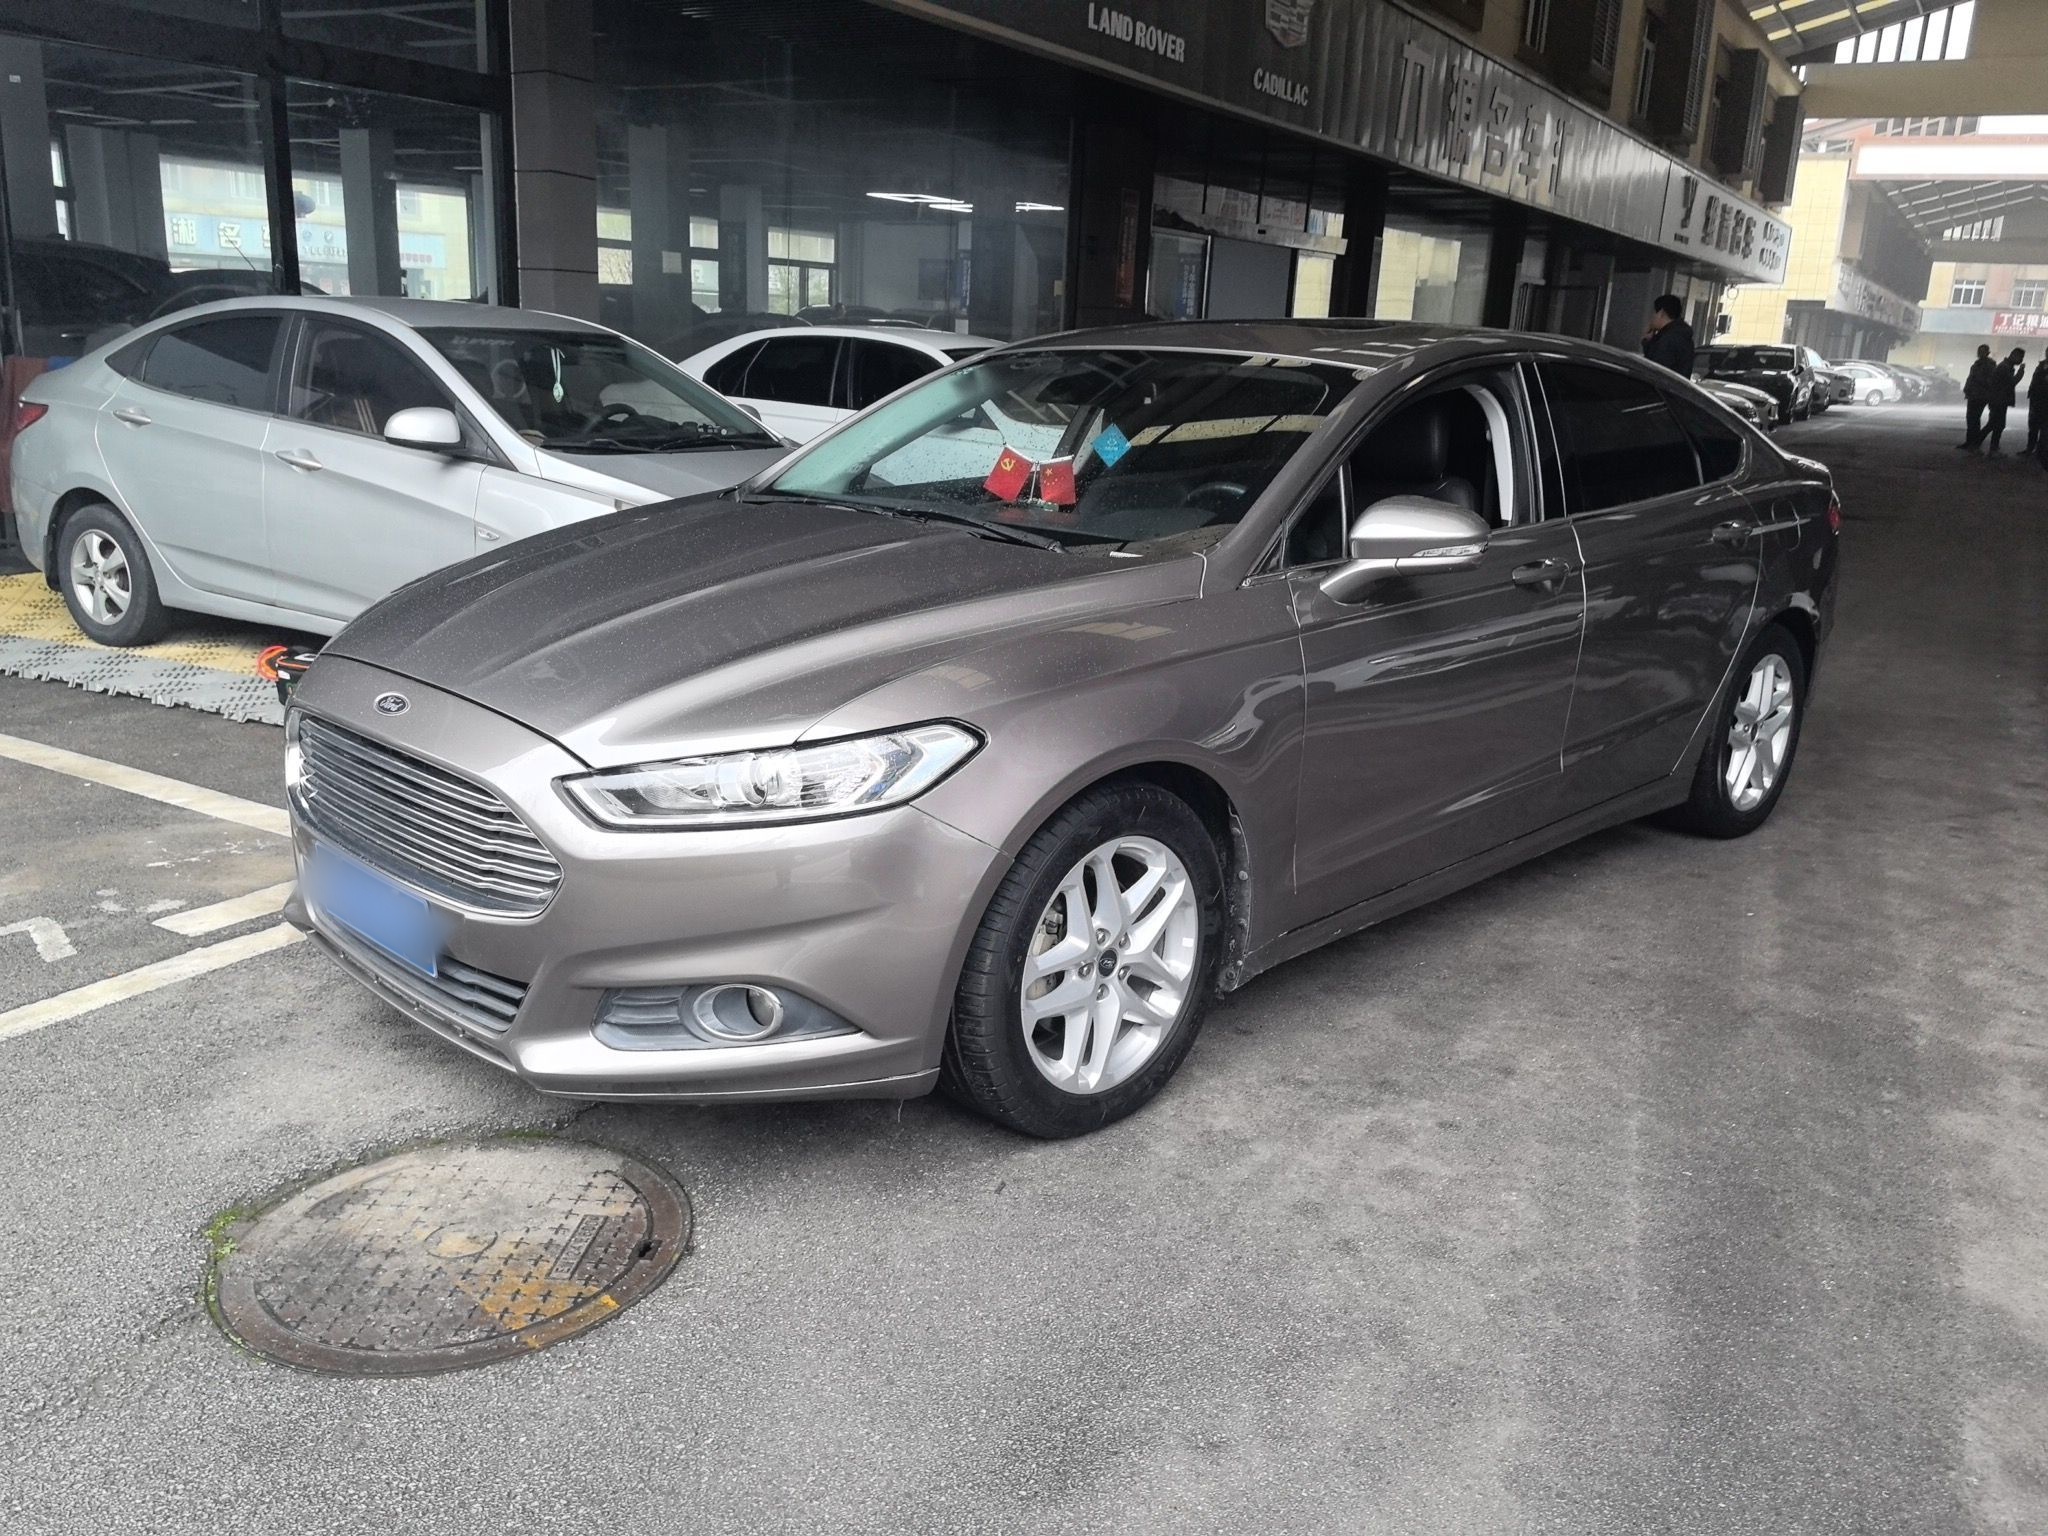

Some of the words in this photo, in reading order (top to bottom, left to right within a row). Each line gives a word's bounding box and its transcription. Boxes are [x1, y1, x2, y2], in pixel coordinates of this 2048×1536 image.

[1088, 2, 1132, 43] LAND
[1135, 20, 1185, 63] ROVER
[1253, 67, 1309, 107] CADILLAC
